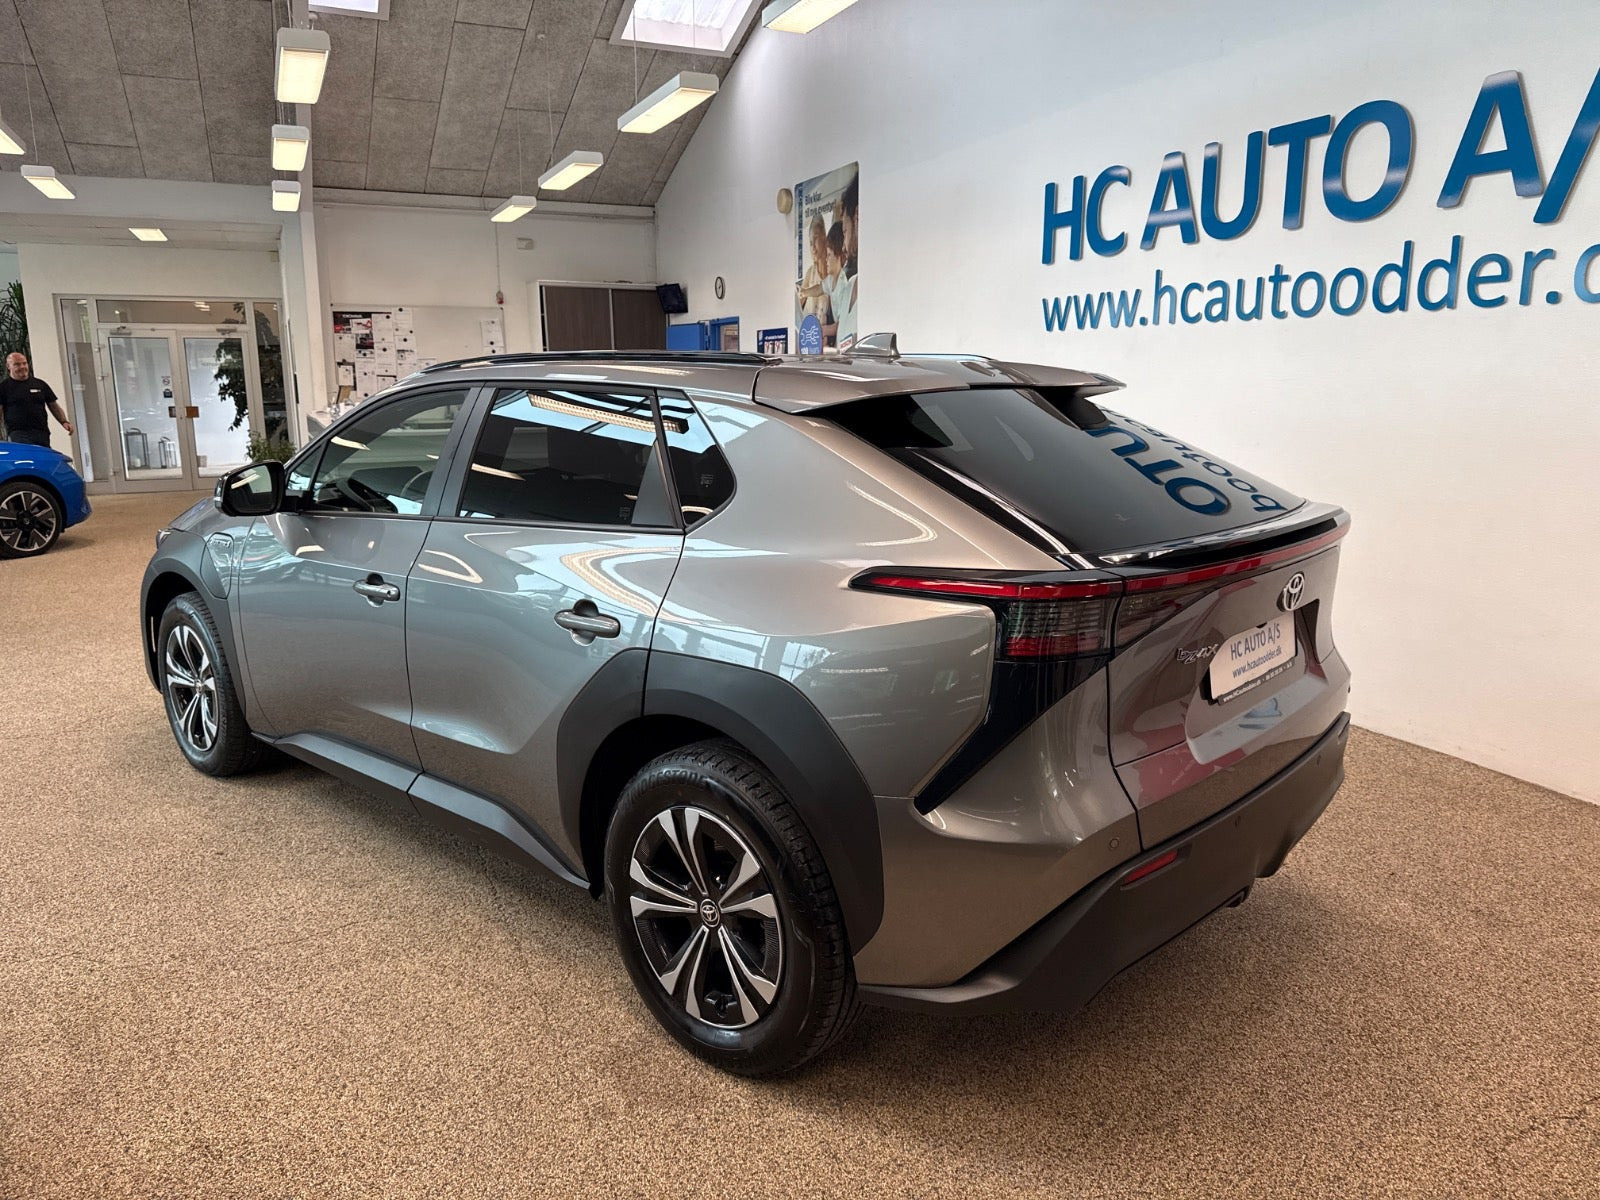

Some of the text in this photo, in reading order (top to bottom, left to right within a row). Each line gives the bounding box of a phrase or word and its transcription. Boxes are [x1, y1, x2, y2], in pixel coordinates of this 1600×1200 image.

[1042, 165, 1131, 265] HC
[1140, 100, 1415, 251] AUTO
[1230, 622, 1281, 660] HC AUTO A/S
[1232, 645, 1282, 679] www.hcautoodder.dk
